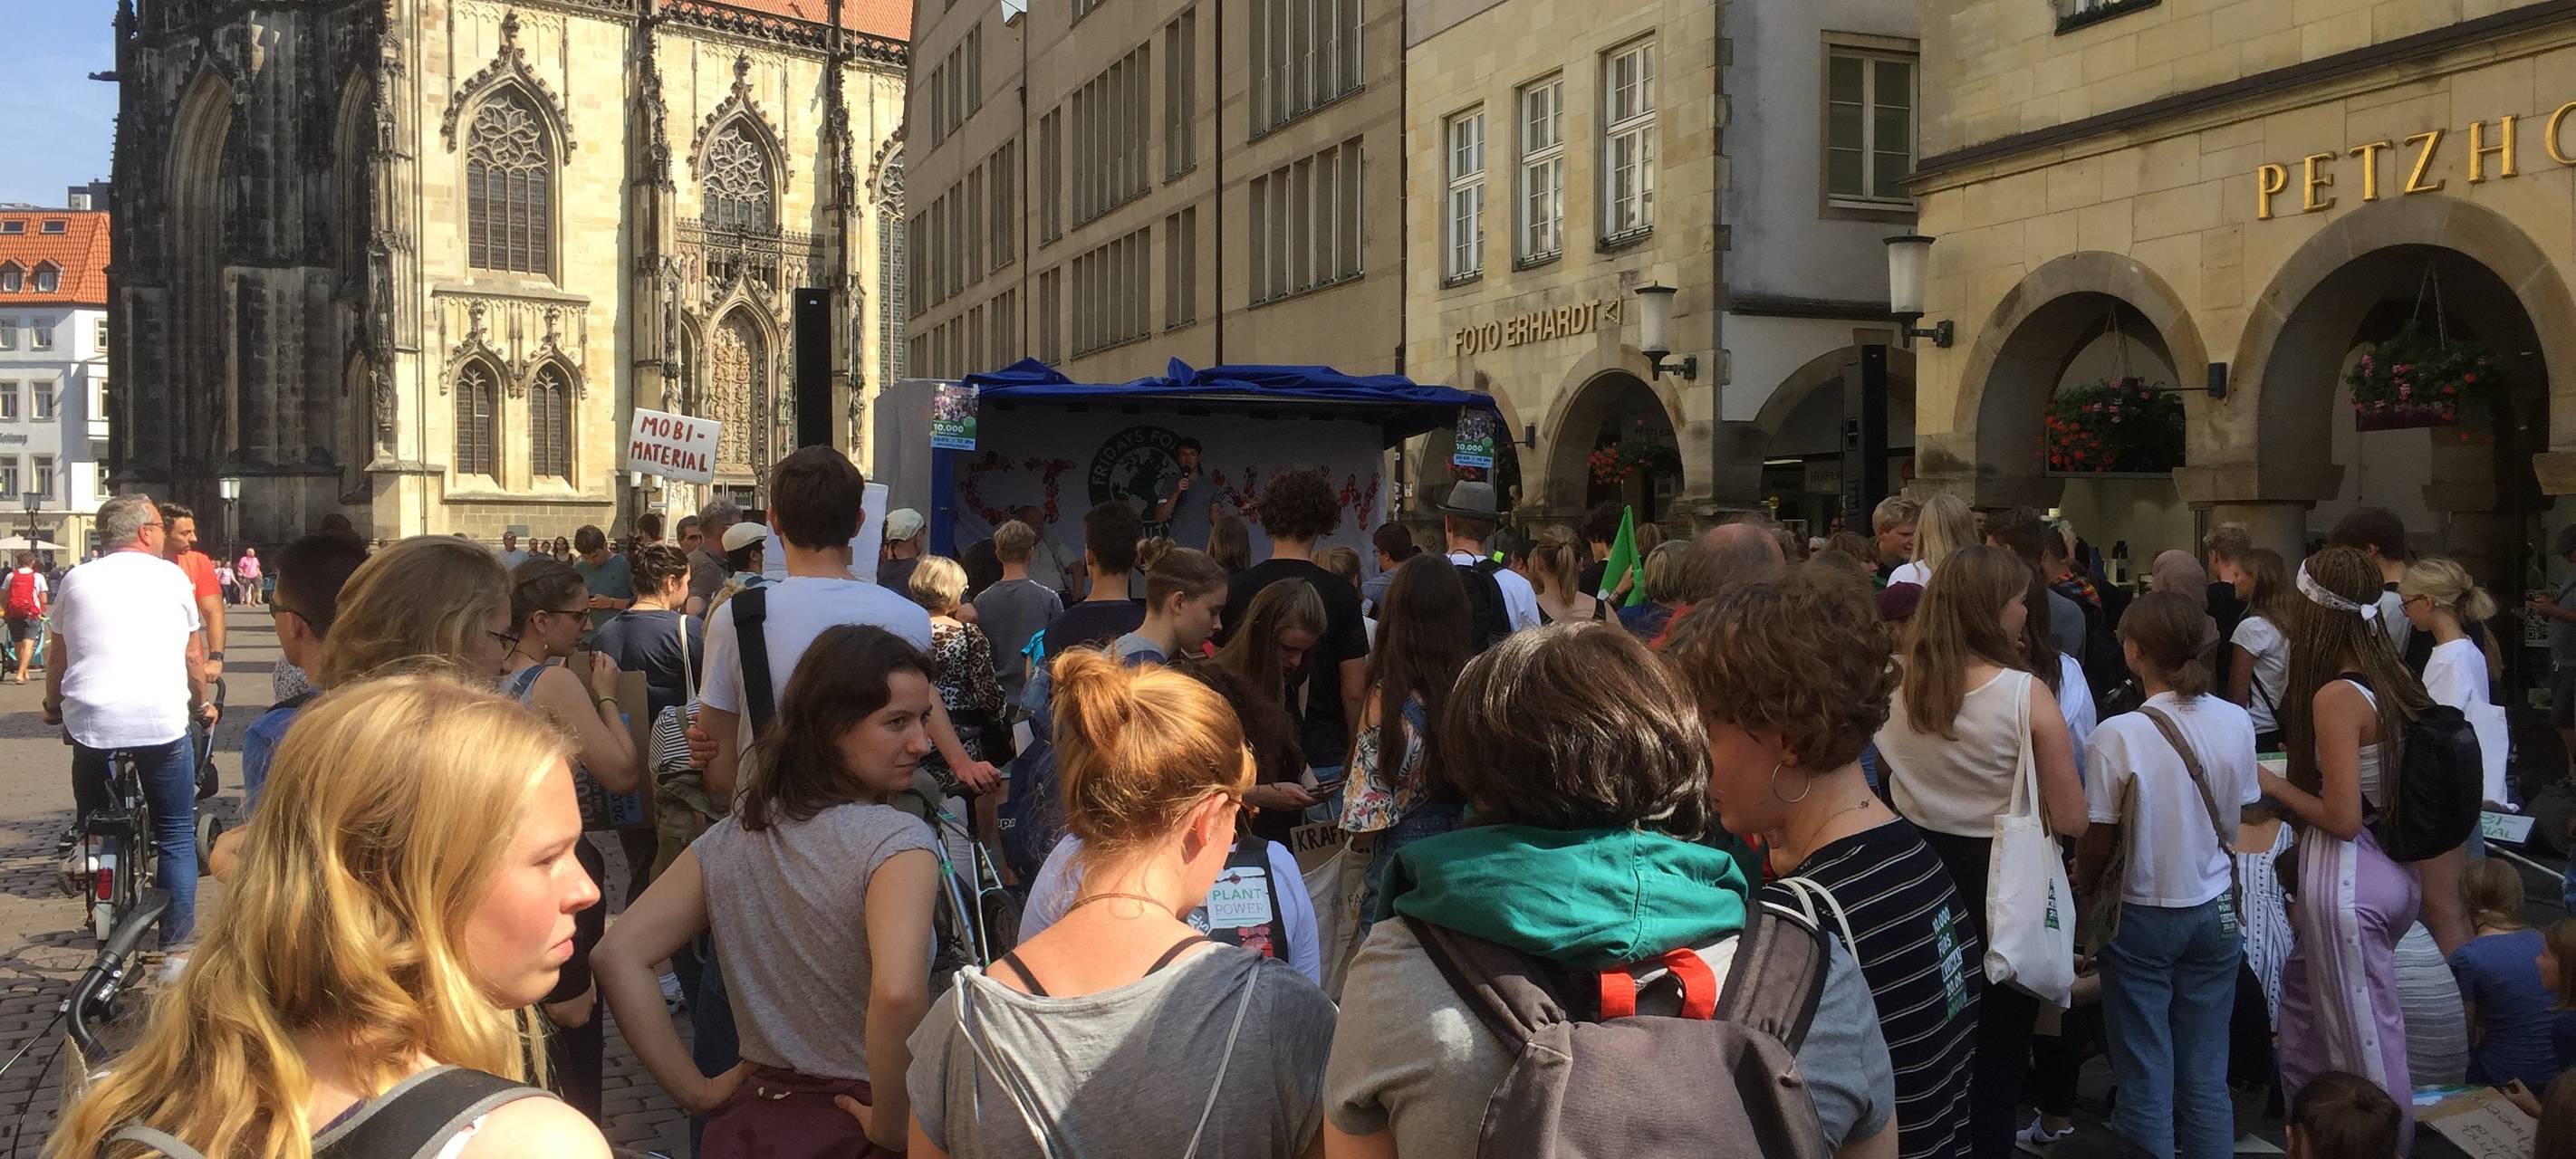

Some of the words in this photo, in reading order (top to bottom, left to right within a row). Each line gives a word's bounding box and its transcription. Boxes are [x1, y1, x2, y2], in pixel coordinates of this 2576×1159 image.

[1452, 320, 1502, 357] FOTO
[1506, 299, 1601, 347] ERHARDT
[640, 416, 705, 443] MOBI-
[933, 423, 965, 433] 10.000
[630, 440, 708, 473] MATERIAL
[1092, 429, 1145, 485] FRIDAYS
[1456, 443, 1483, 452] 10.000
[1212, 888, 1262, 901] PLANT
[1214, 903, 1264, 915] POWER
